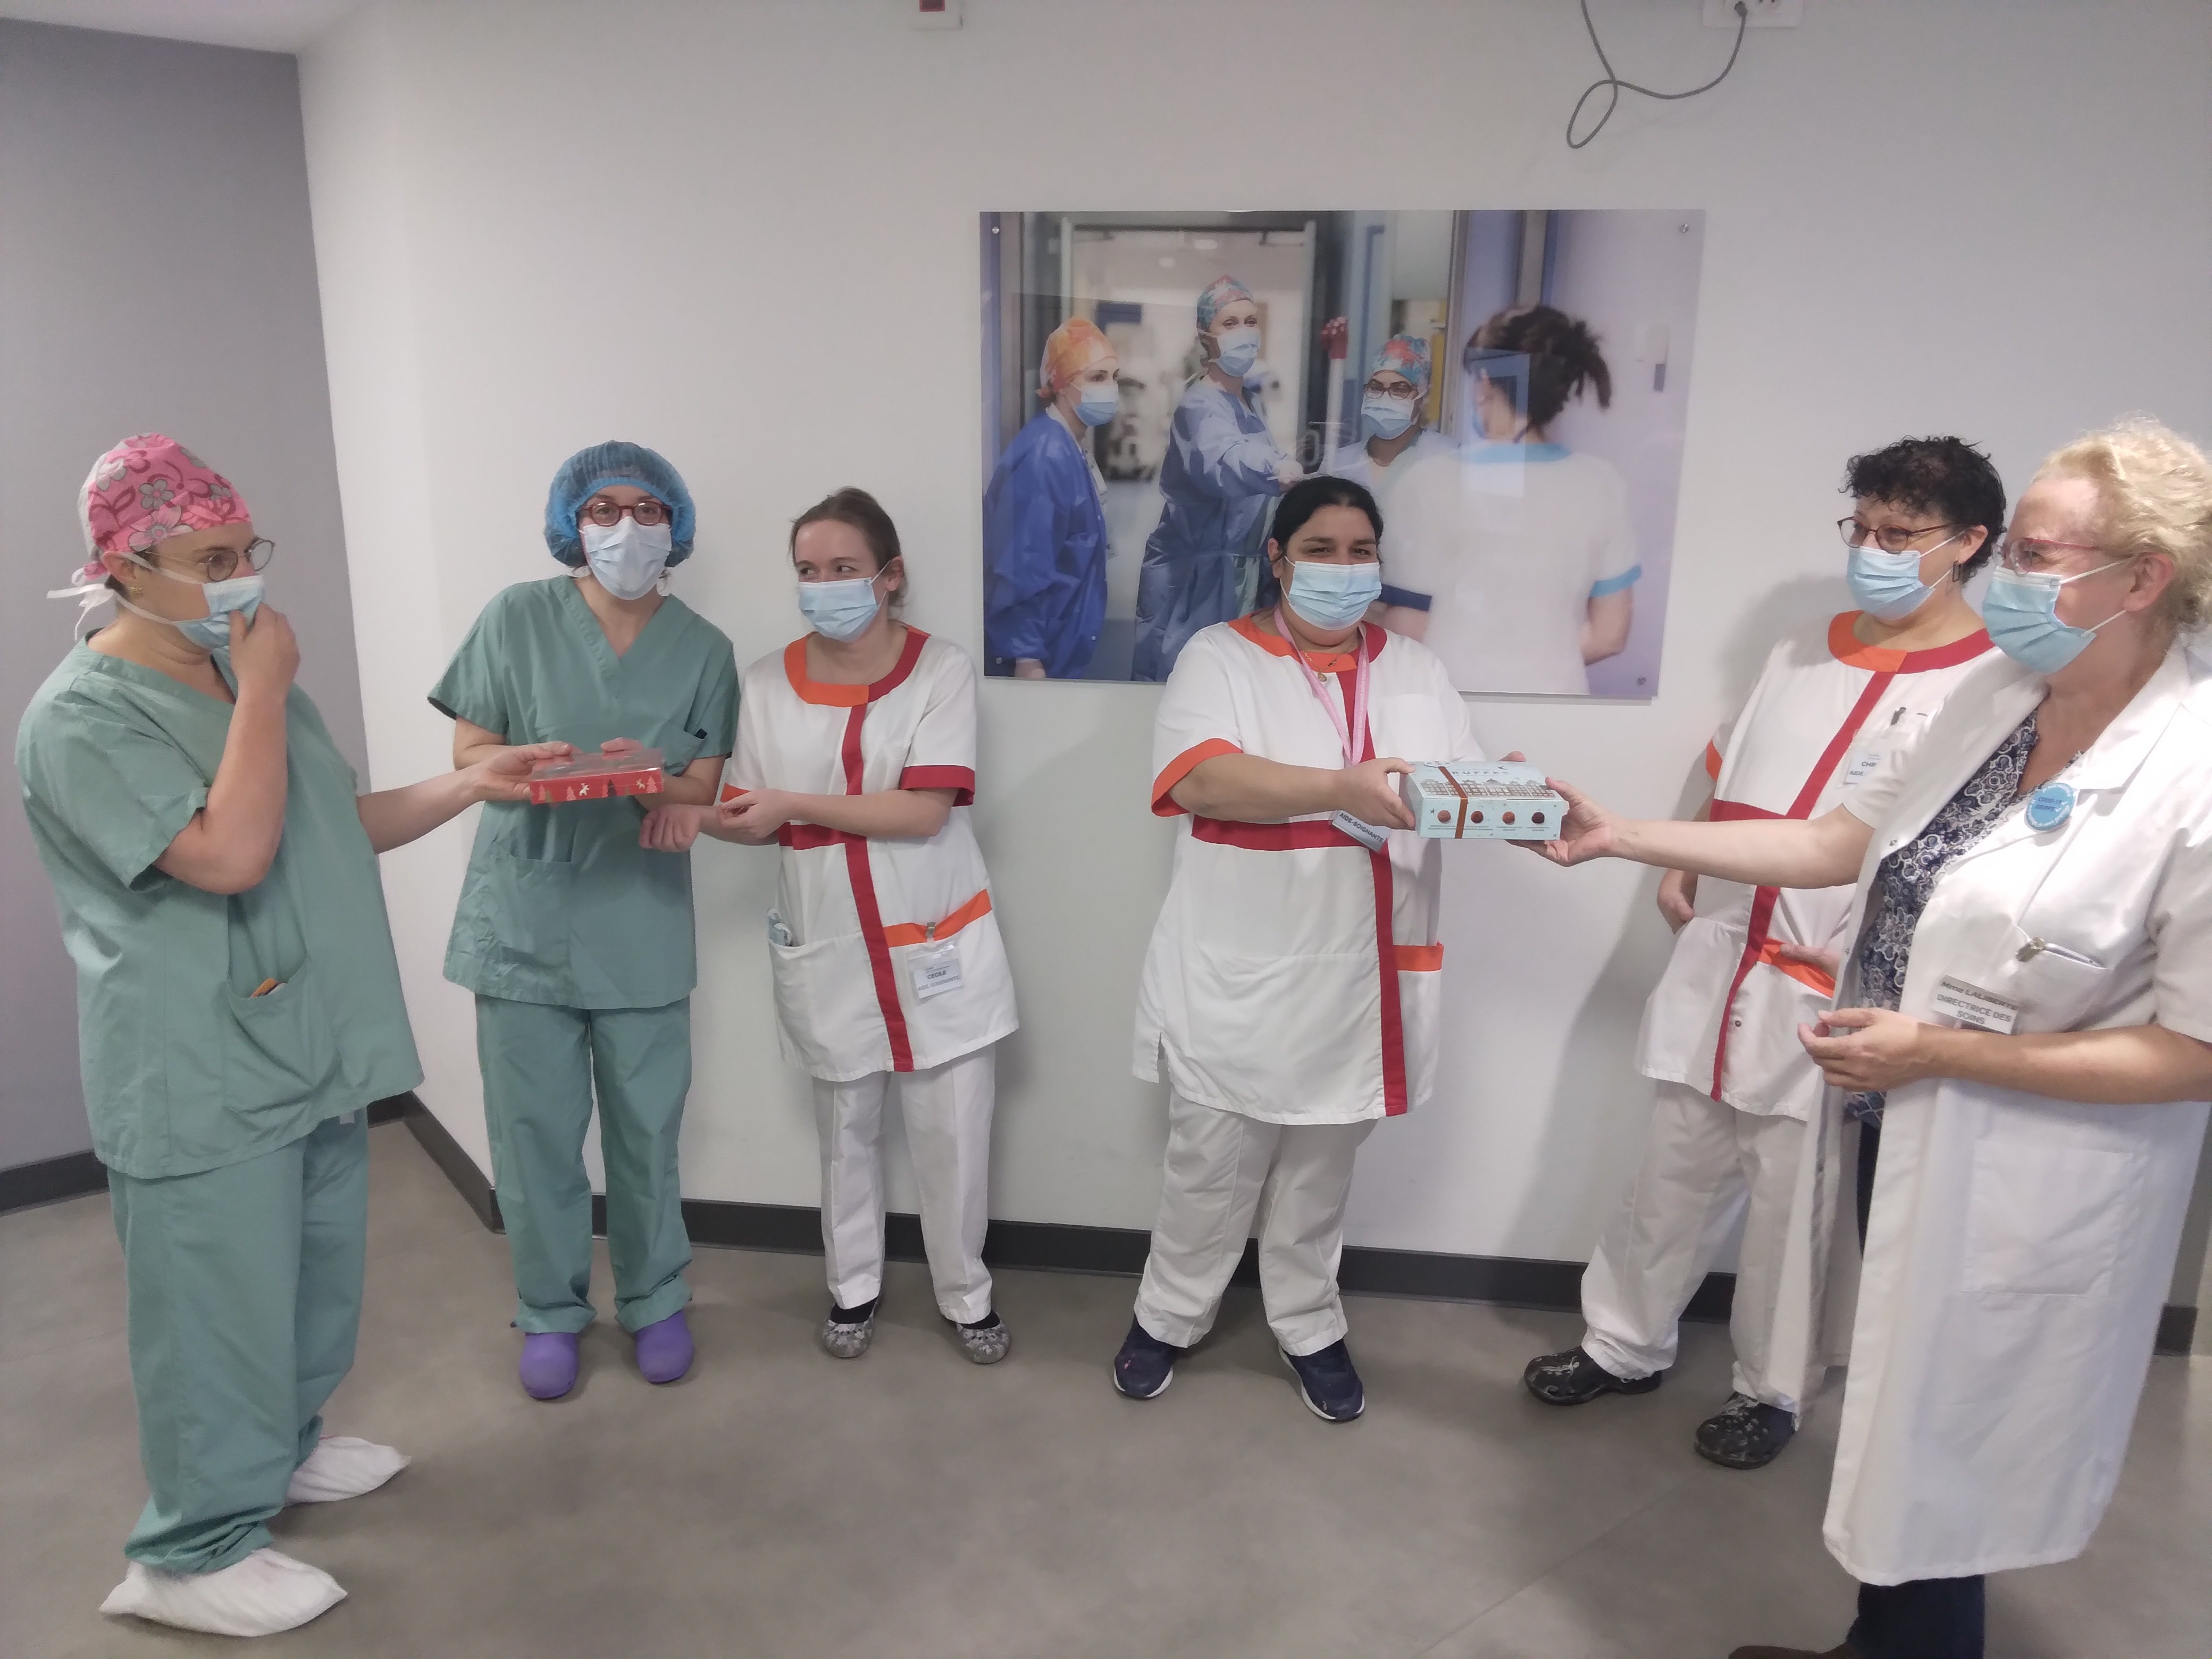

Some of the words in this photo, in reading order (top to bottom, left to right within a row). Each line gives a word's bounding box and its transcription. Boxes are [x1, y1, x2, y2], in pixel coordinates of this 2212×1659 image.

[1339, 812, 1384, 843] AIDE-SOIGNANTE
[927, 970, 946, 979] CECILE
[1937, 994, 1991, 1016] DIRECTRICE
[1993, 1011, 2012, 1022] DES
[1957, 1010, 1985, 1025] SOINS
